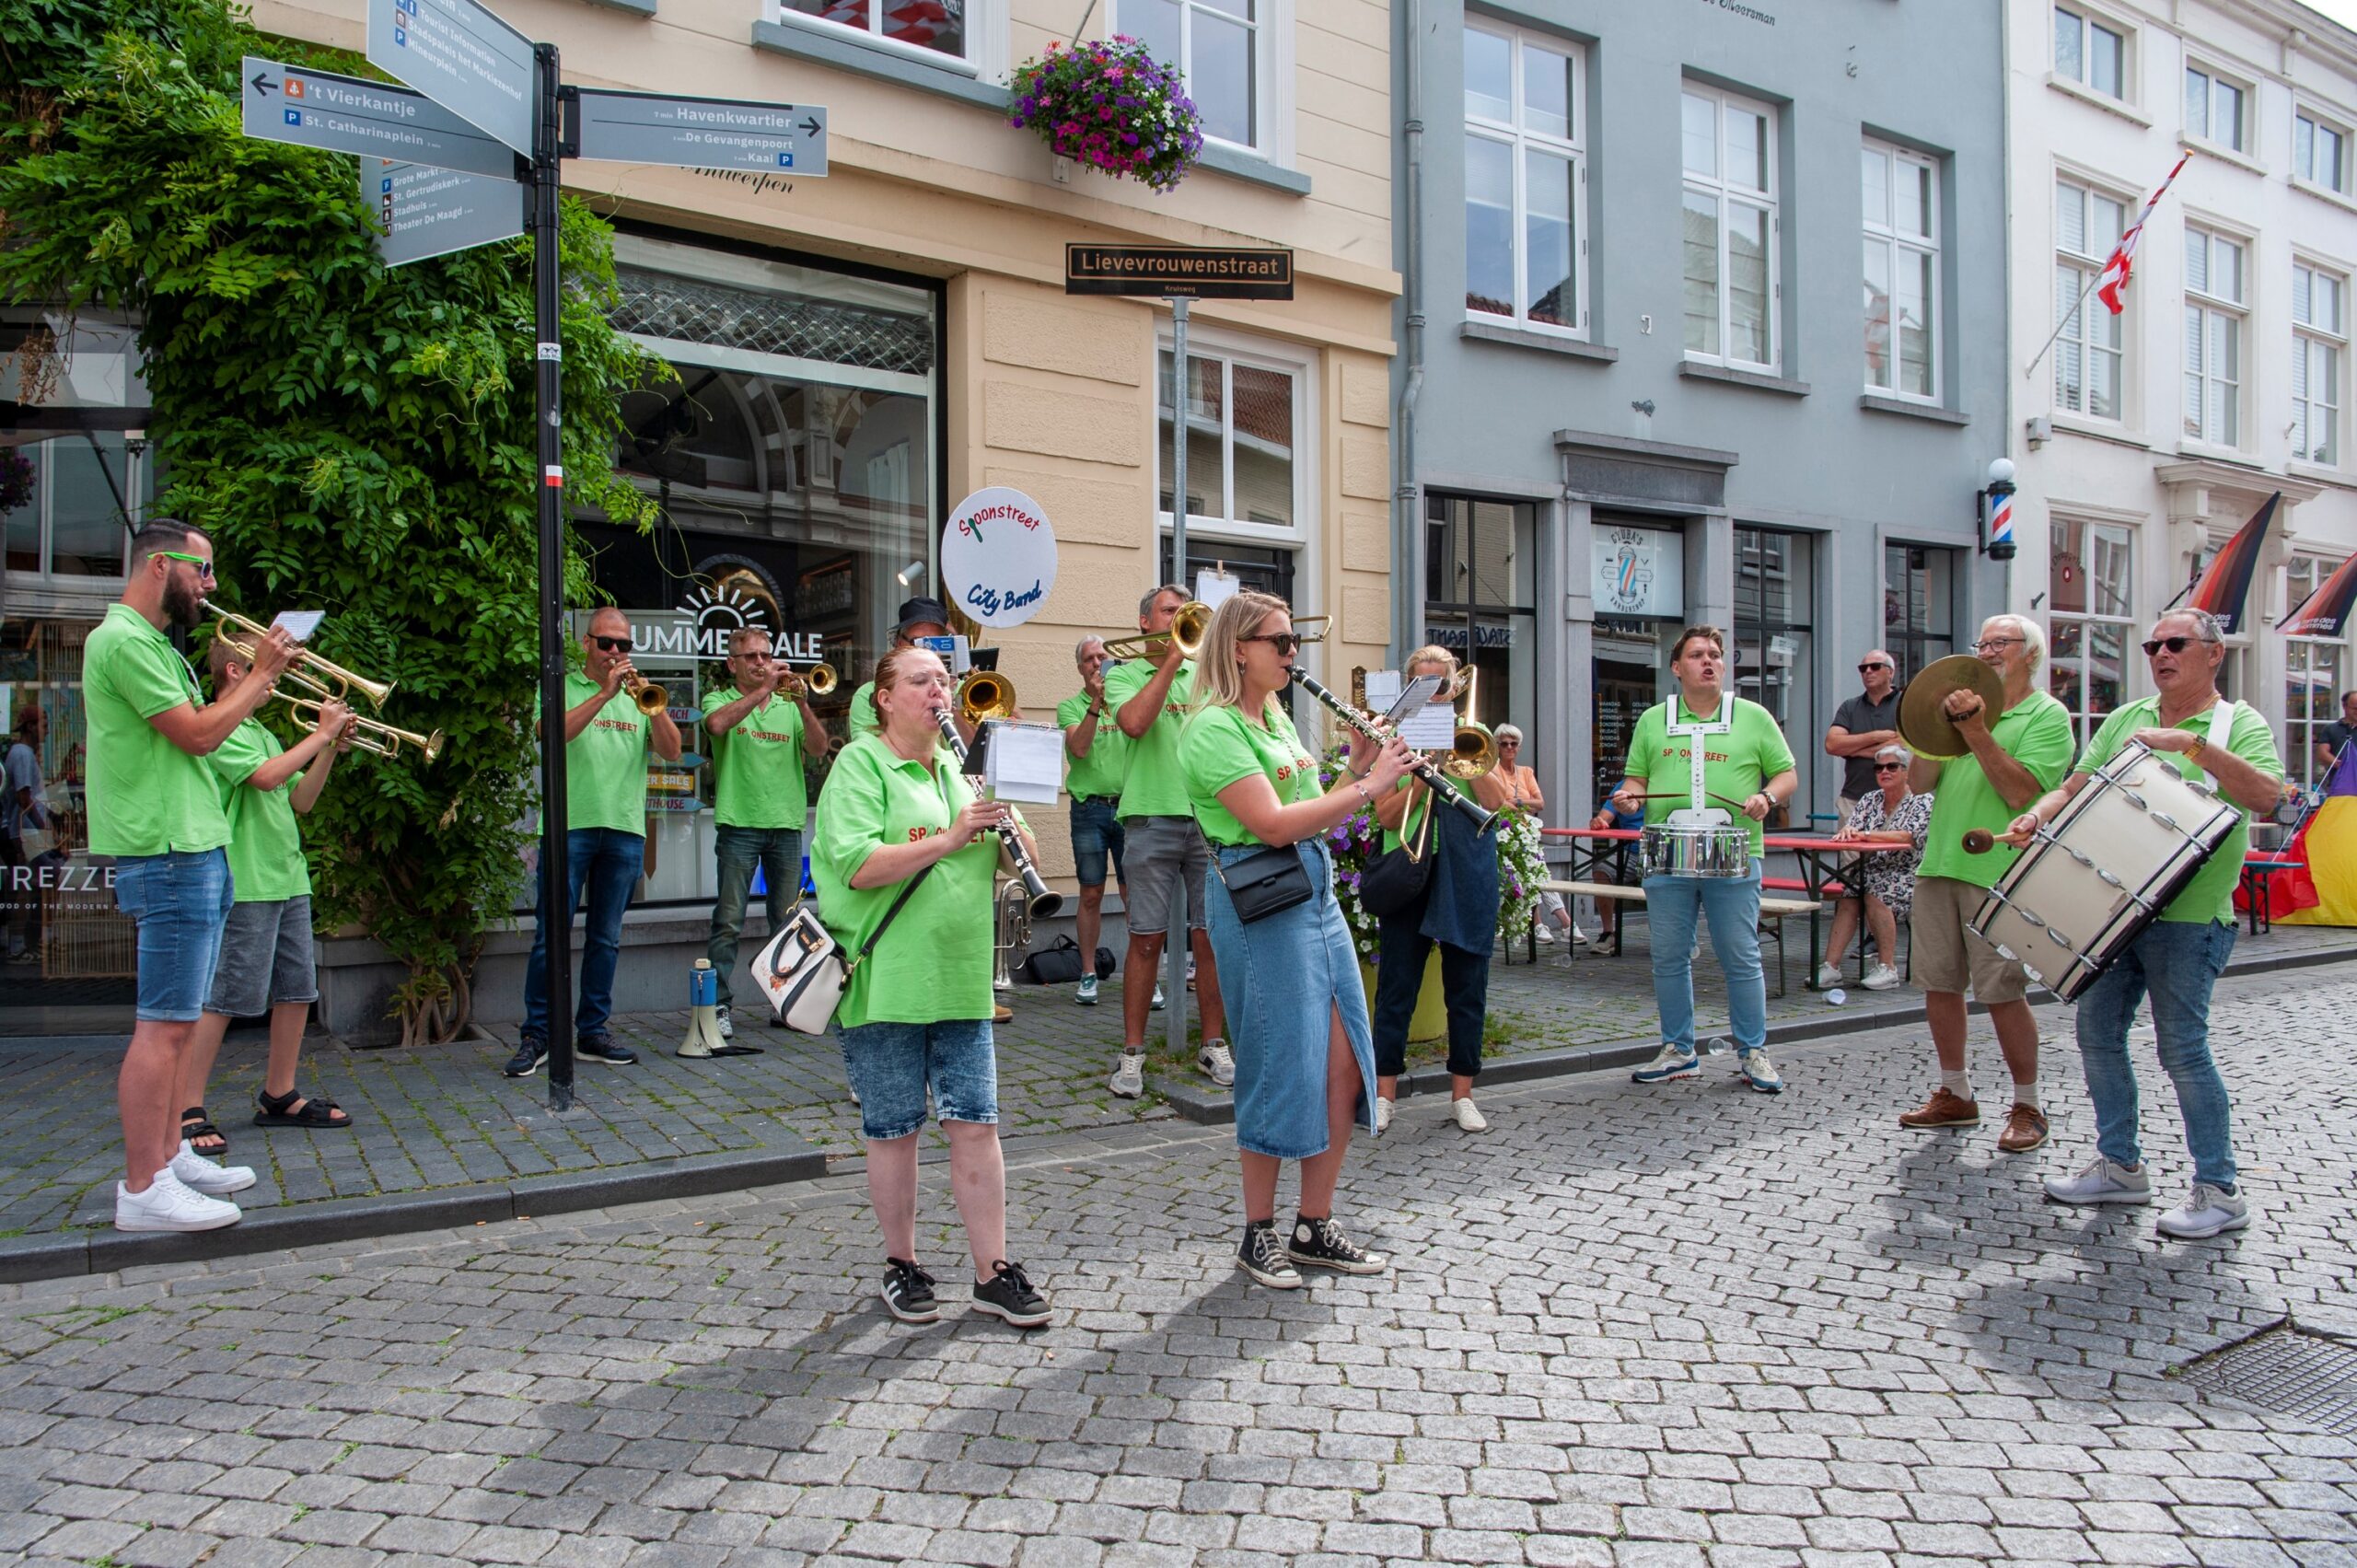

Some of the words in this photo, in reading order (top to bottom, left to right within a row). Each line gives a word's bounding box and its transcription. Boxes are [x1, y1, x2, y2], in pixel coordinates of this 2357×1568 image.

[420, 8, 448, 35] Tourist
[450, 28, 495, 67] Information
[408, 38, 457, 76] Mineurplein
[409, 20, 459, 58] Stadspaleis
[459, 52, 470, 69] het
[473, 64, 522, 101] Markiezenhof
[327, 88, 416, 117] Vierkantje
[305, 115, 323, 127] St.
[328, 120, 424, 145] Catharinaplein
[678, 108, 792, 128] Havenkwartier
[686, 132, 701, 143] De
[704, 134, 793, 150] Gevangenpoort
[748, 152, 773, 163] Kaai
[393, 173, 414, 187] Grote
[416, 168, 439, 181] Markt
[393, 192, 404, 203] St.
[406, 176, 460, 198] Gertrudiskerk
[393, 201, 426, 217] Stadhuis
[394, 219, 423, 232] Theater
[424, 214, 435, 225] De
[436, 206, 463, 221] Maagd
[1082, 252, 1278, 274] Lievevrouwenstraat
[1165, 285, 1196, 295] Kruisweg
[968, 584, 1001, 617] City
[1004, 579, 1042, 610] Band
[631, 625, 729, 655] UMME
[769, 632, 822, 657] ALE
[662, 775, 690, 786] SALE
